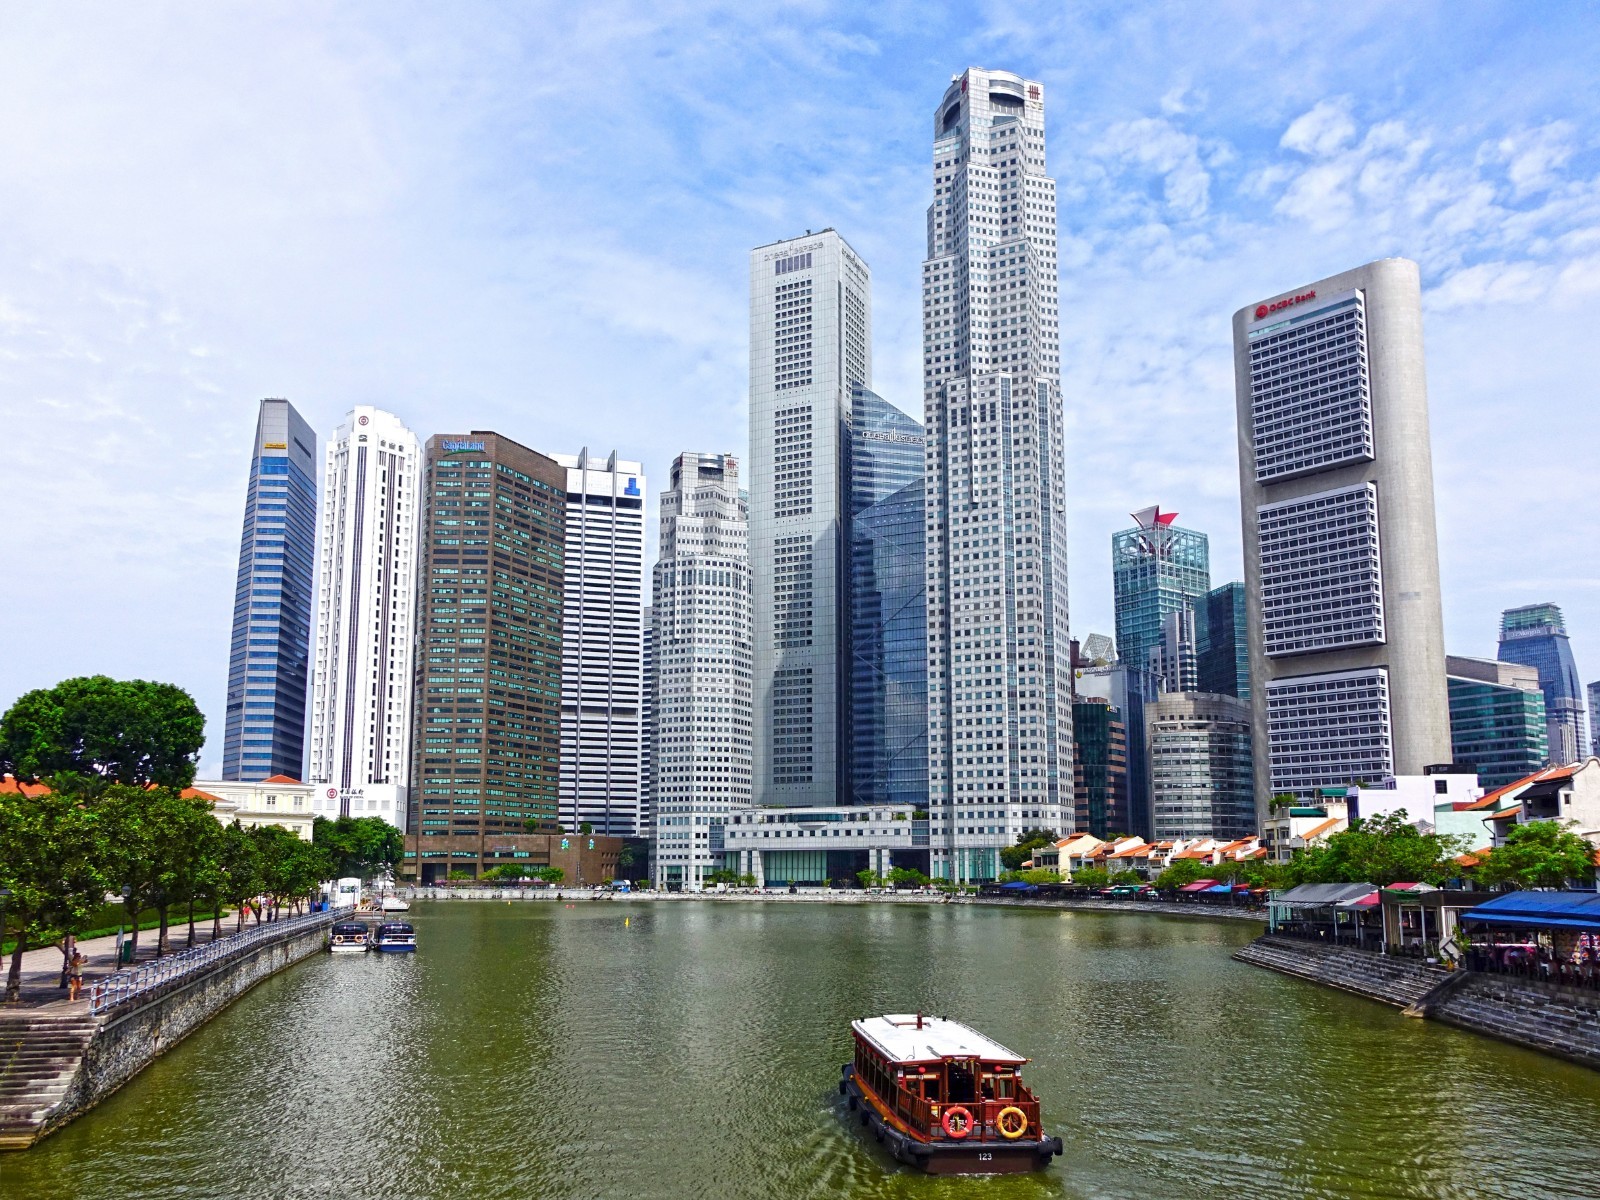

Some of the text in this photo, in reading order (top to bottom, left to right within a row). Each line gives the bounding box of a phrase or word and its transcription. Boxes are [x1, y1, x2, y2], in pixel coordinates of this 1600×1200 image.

[1269, 290, 1316, 311] OCBC Bank
[978, 1152, 993, 1161] 123
